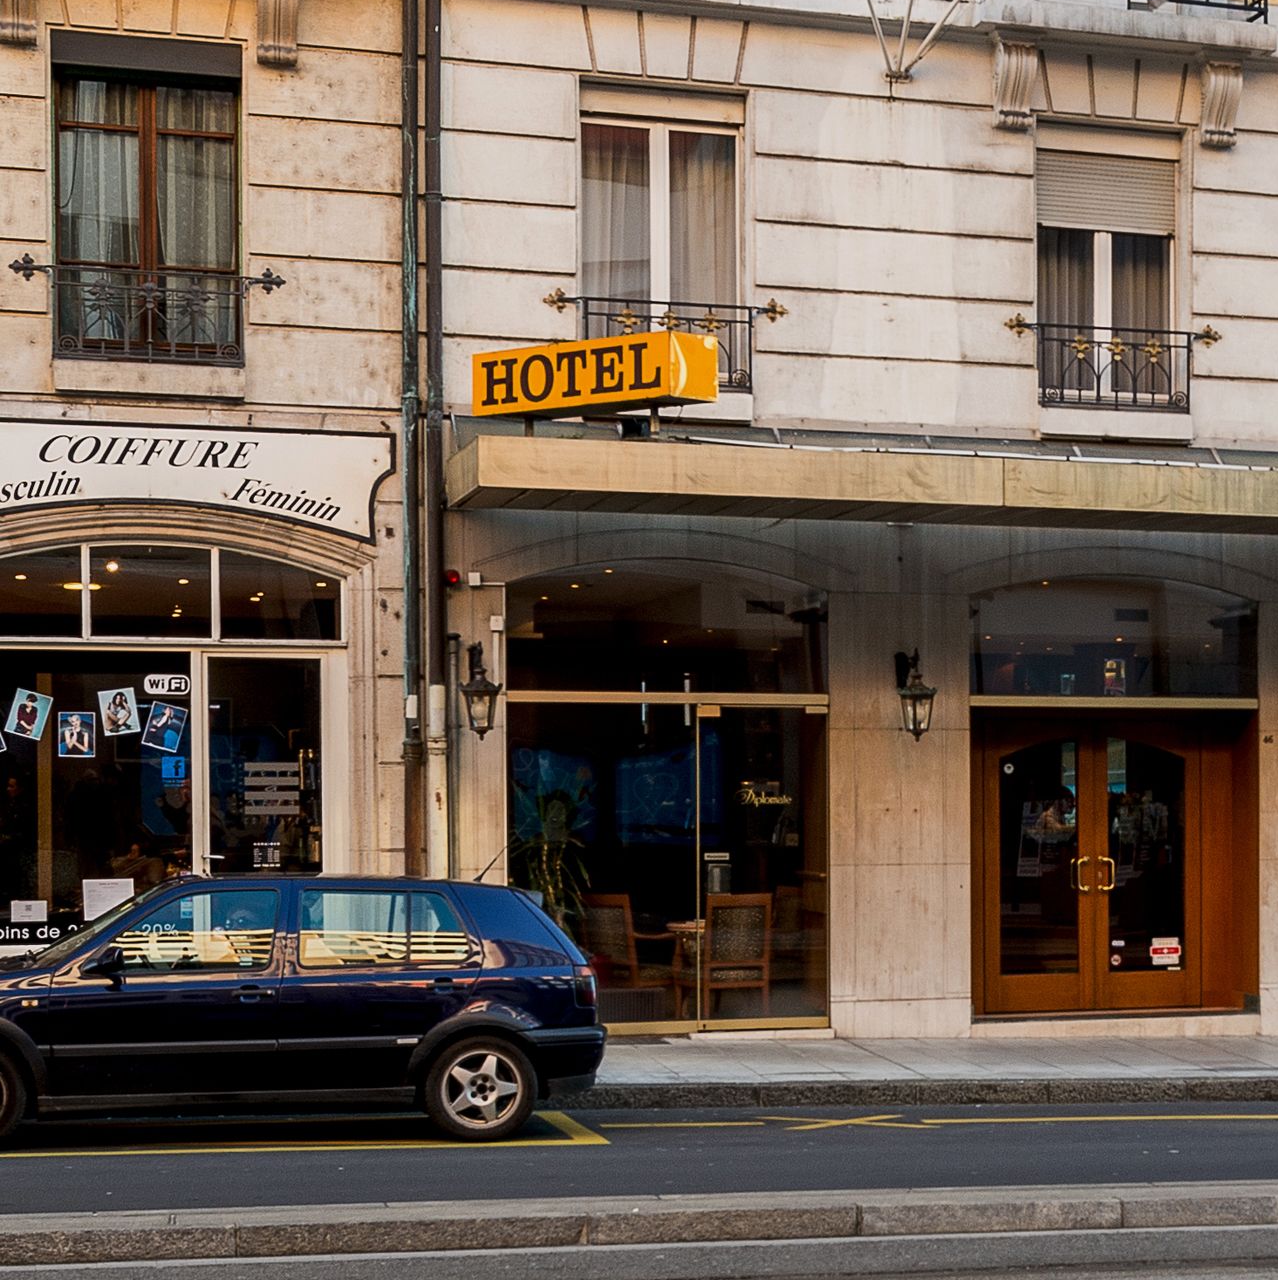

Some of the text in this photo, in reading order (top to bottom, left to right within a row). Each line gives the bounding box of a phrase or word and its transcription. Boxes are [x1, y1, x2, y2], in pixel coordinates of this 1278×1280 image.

[481, 342, 661, 407] HOTEL
[38, 434, 259, 469] COIFFURE
[230, 478, 341, 522] Féminin
[36, 925, 61, 939] de
